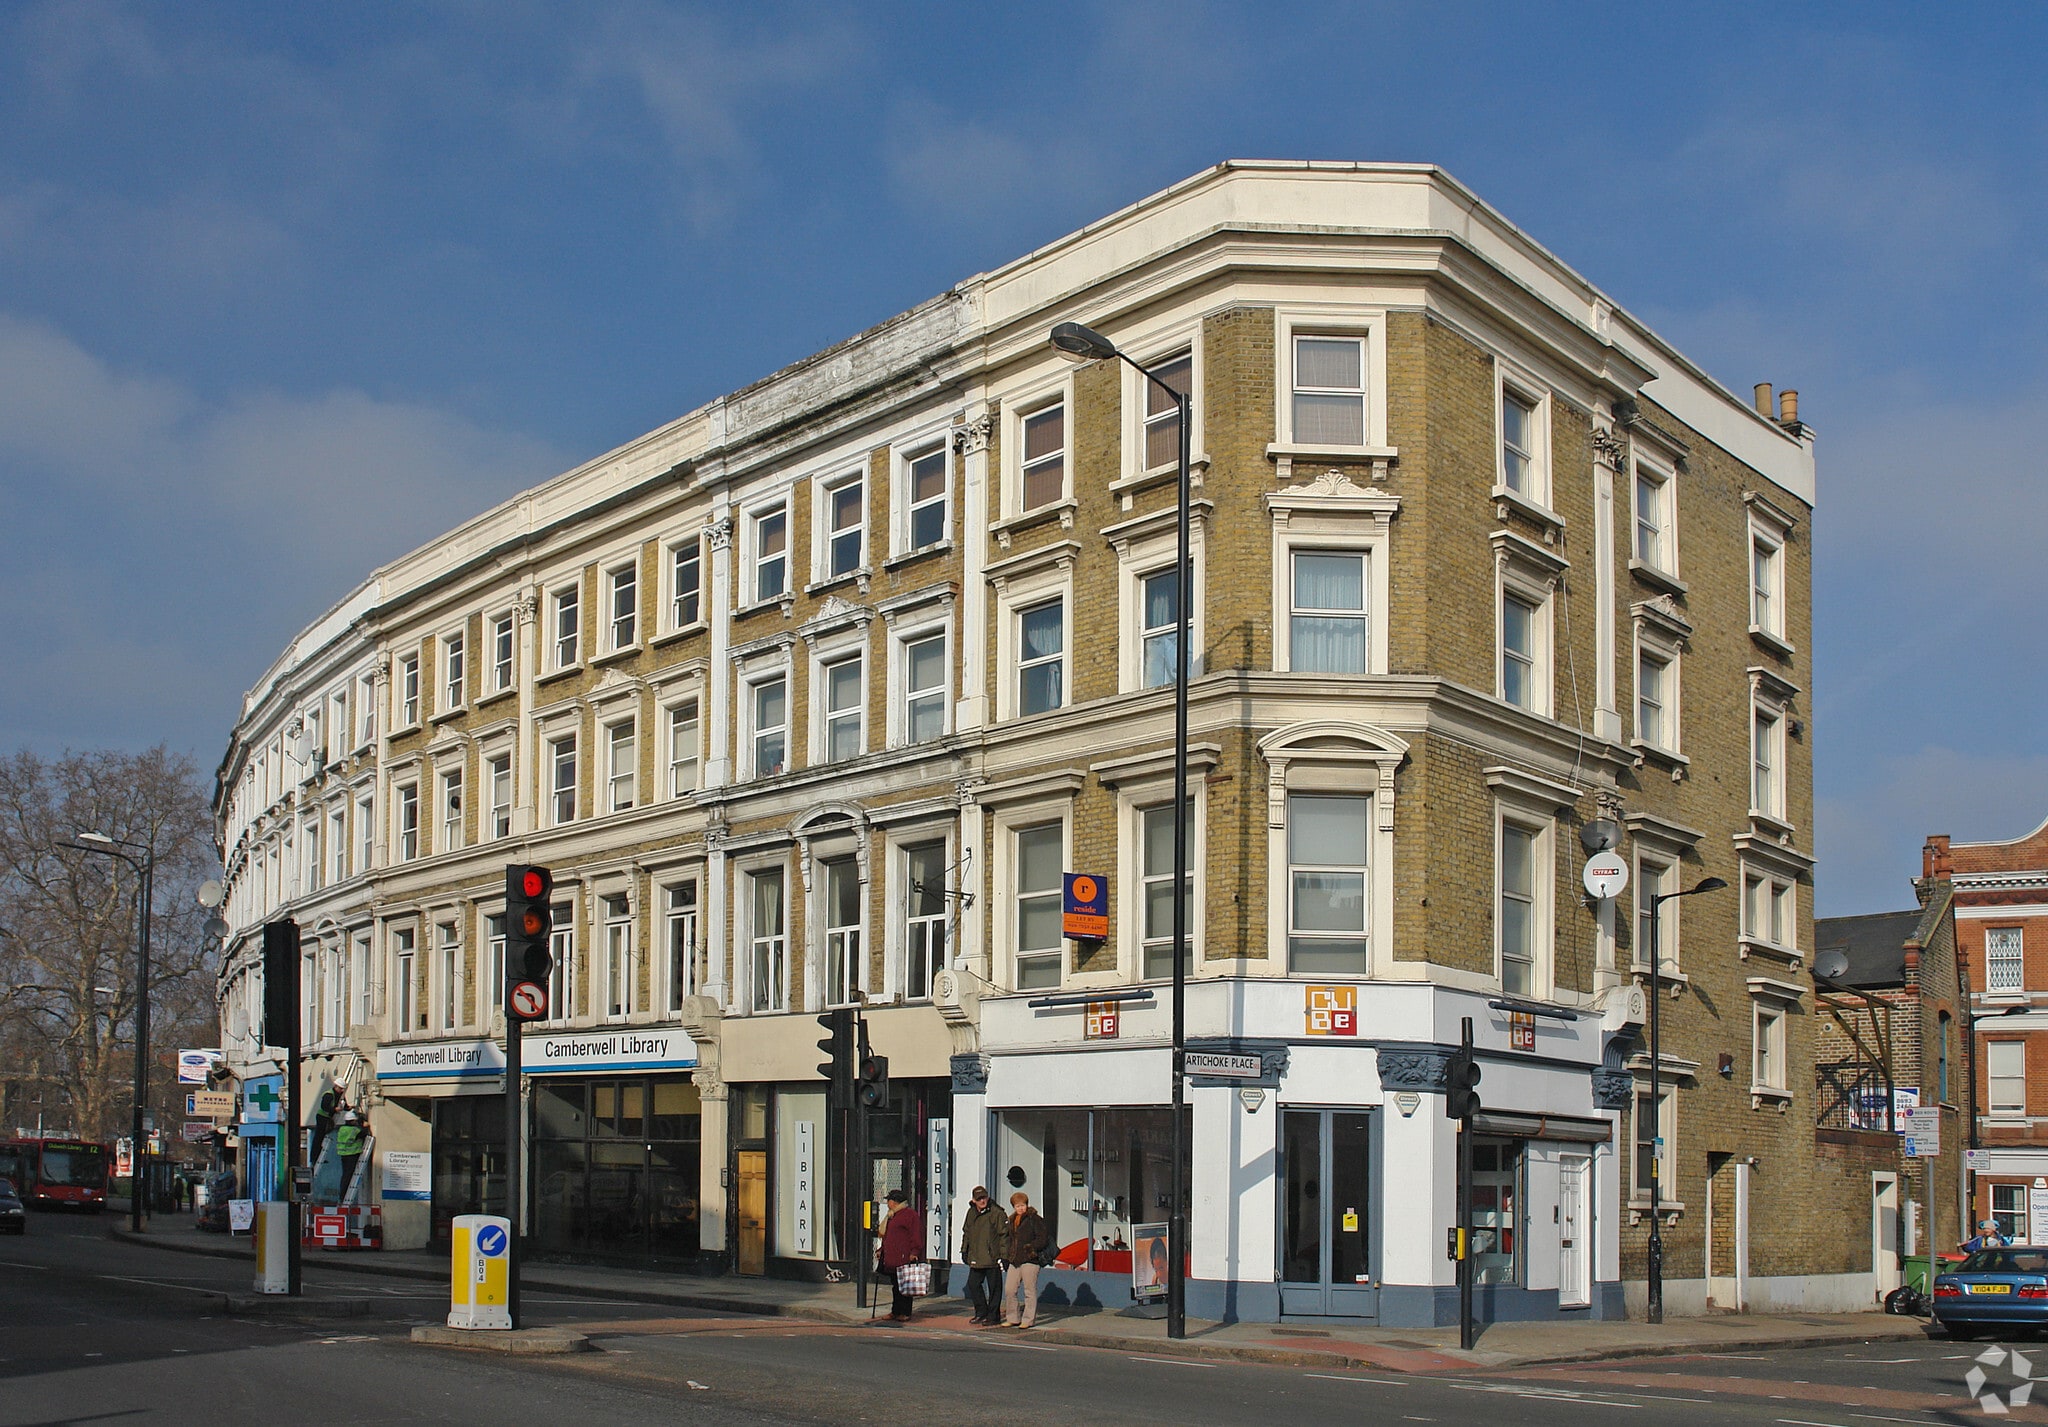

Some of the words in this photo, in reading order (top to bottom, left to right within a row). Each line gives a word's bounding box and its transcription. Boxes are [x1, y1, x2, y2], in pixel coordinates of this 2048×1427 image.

[1081, 885, 1088, 893] r
[545, 1037, 616, 1057] Camberwell
[621, 1036, 669, 1057] Library
[395, 1049, 445, 1066] Camberwell
[448, 1048, 482, 1066] Library
[1186, 1055, 1228, 1067] ARTICHOKE
[1231, 1058, 1253, 1069] PLACE
[90, 1146, 98, 1154] 12
[934, 1121, 942, 1257] LIBRARY
